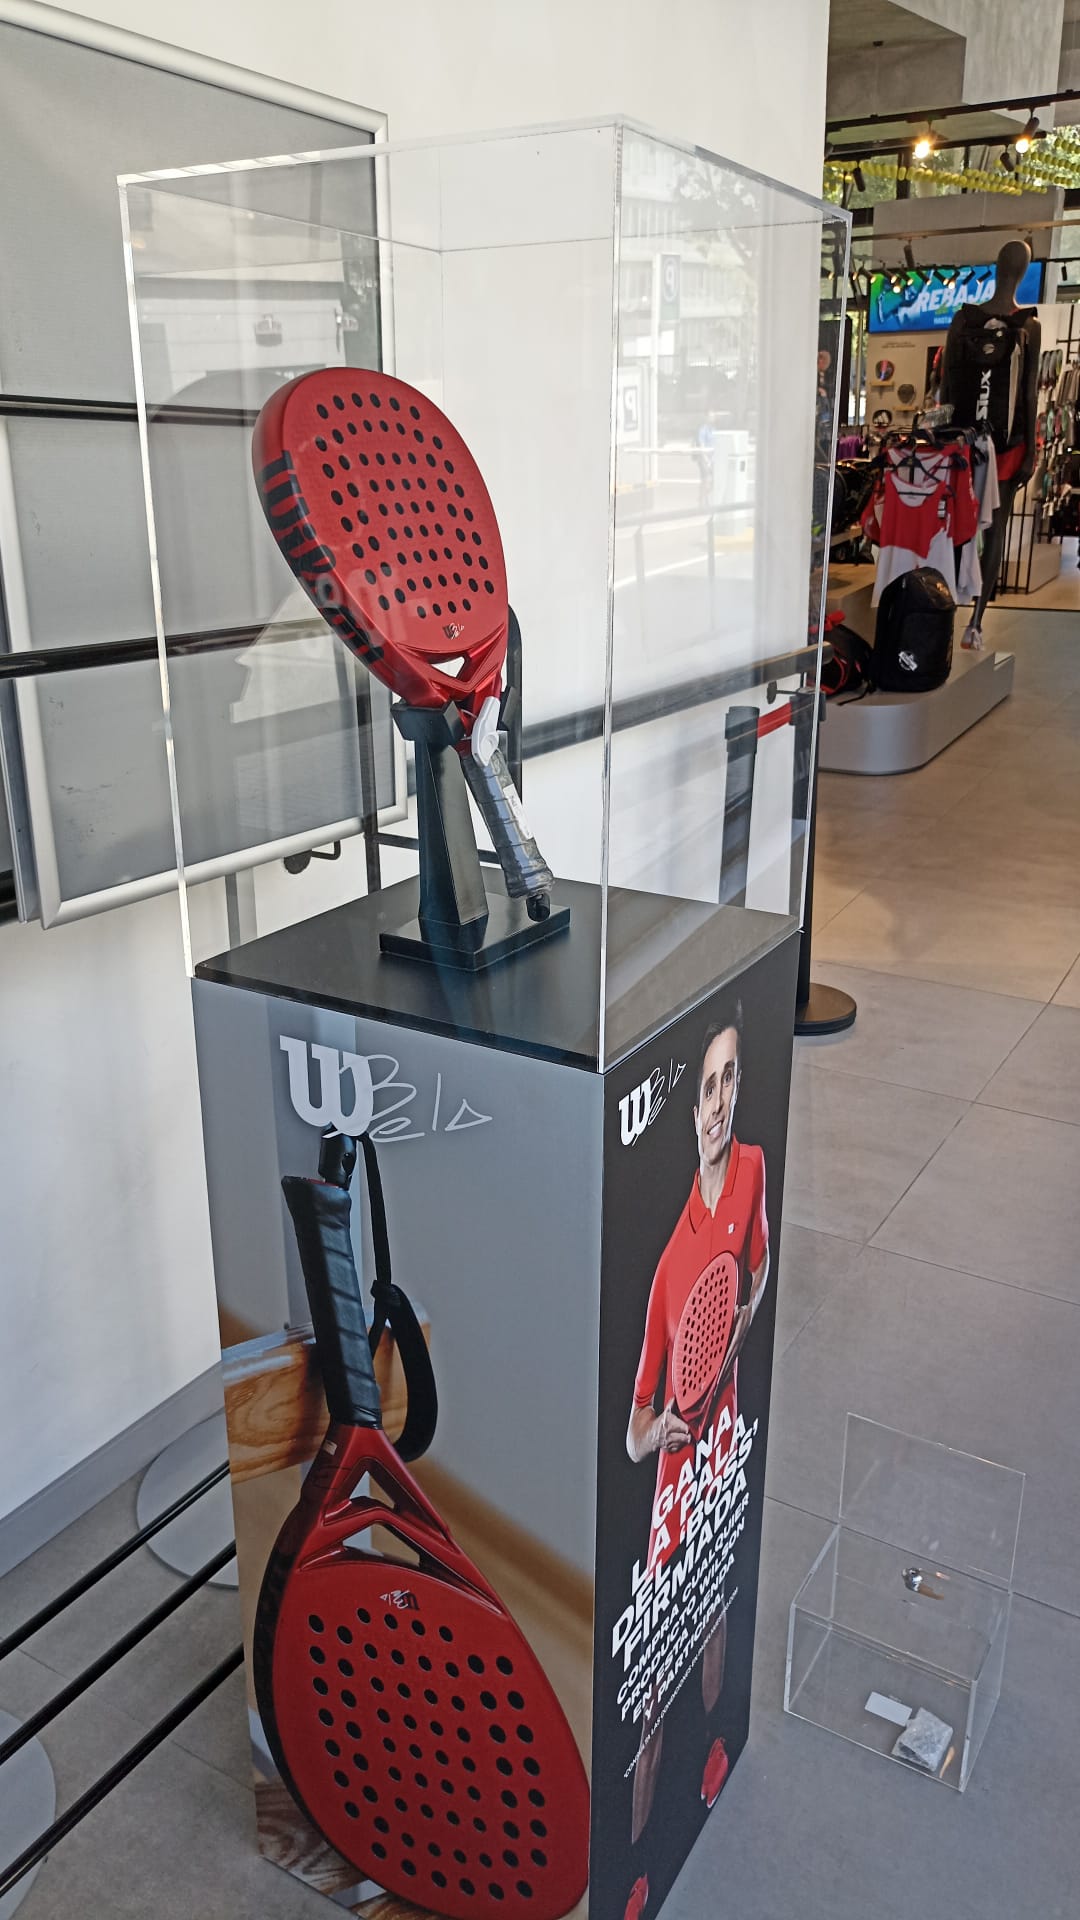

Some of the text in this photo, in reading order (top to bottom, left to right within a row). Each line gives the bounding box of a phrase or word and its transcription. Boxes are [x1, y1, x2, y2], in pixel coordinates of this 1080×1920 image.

[917, 278, 997, 312] REBAJA
[631, 1523, 671, 1597] LA
[679, 1413, 747, 1527] PALA
[653, 1405, 732, 1529] GANA
[611, 1559, 672, 1659] DEL
[616, 1603, 679, 1705] COMPRA
[682, 1492, 750, 1603] CUALQUIER
[621, 1594, 697, 1723] PRODUCTO
[699, 1516, 746, 1595] WILSON
[623, 1467, 748, 1673] FIRMADA
[632, 1683, 652, 1724] EN
[655, 1627, 689, 1686] ESTA
[691, 1552, 735, 1625] TIENDA
[644, 1698, 655, 1721] Y
[657, 1593, 724, 1703] PARTICIPA.
